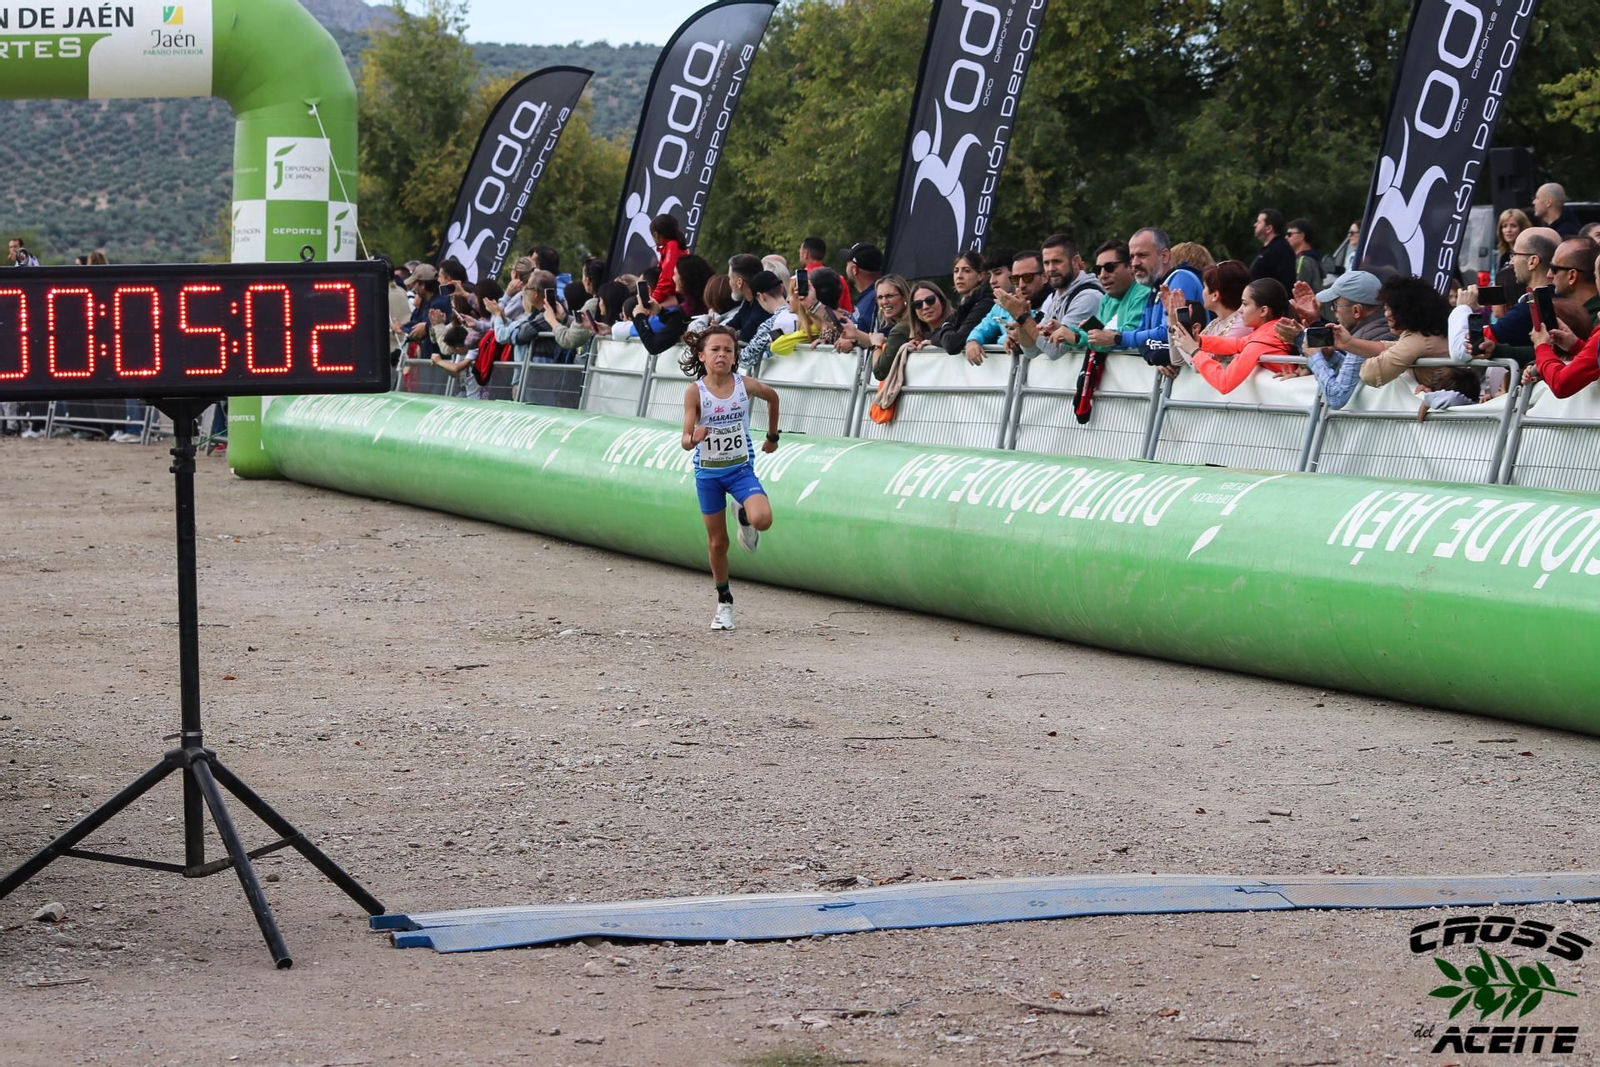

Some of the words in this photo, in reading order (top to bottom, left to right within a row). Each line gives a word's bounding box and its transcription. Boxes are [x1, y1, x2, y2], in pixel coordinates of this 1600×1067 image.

[18, 7, 55, 29] DE
[62, 2, 134, 28] JAÉN
[151, 29, 196, 48] Jaén
[272, 227, 322, 236] DEPORTES
[602, 426, 674, 475] JAÉN
[704, 434, 743, 452] 1126
[883, 453, 982, 509] JAÉN
[948, 458, 1021, 505] DE
[987, 462, 1203, 526] DIPUTACIÓN
[1327, 490, 1473, 565] JAÉN
[1433, 498, 1537, 562] DE
